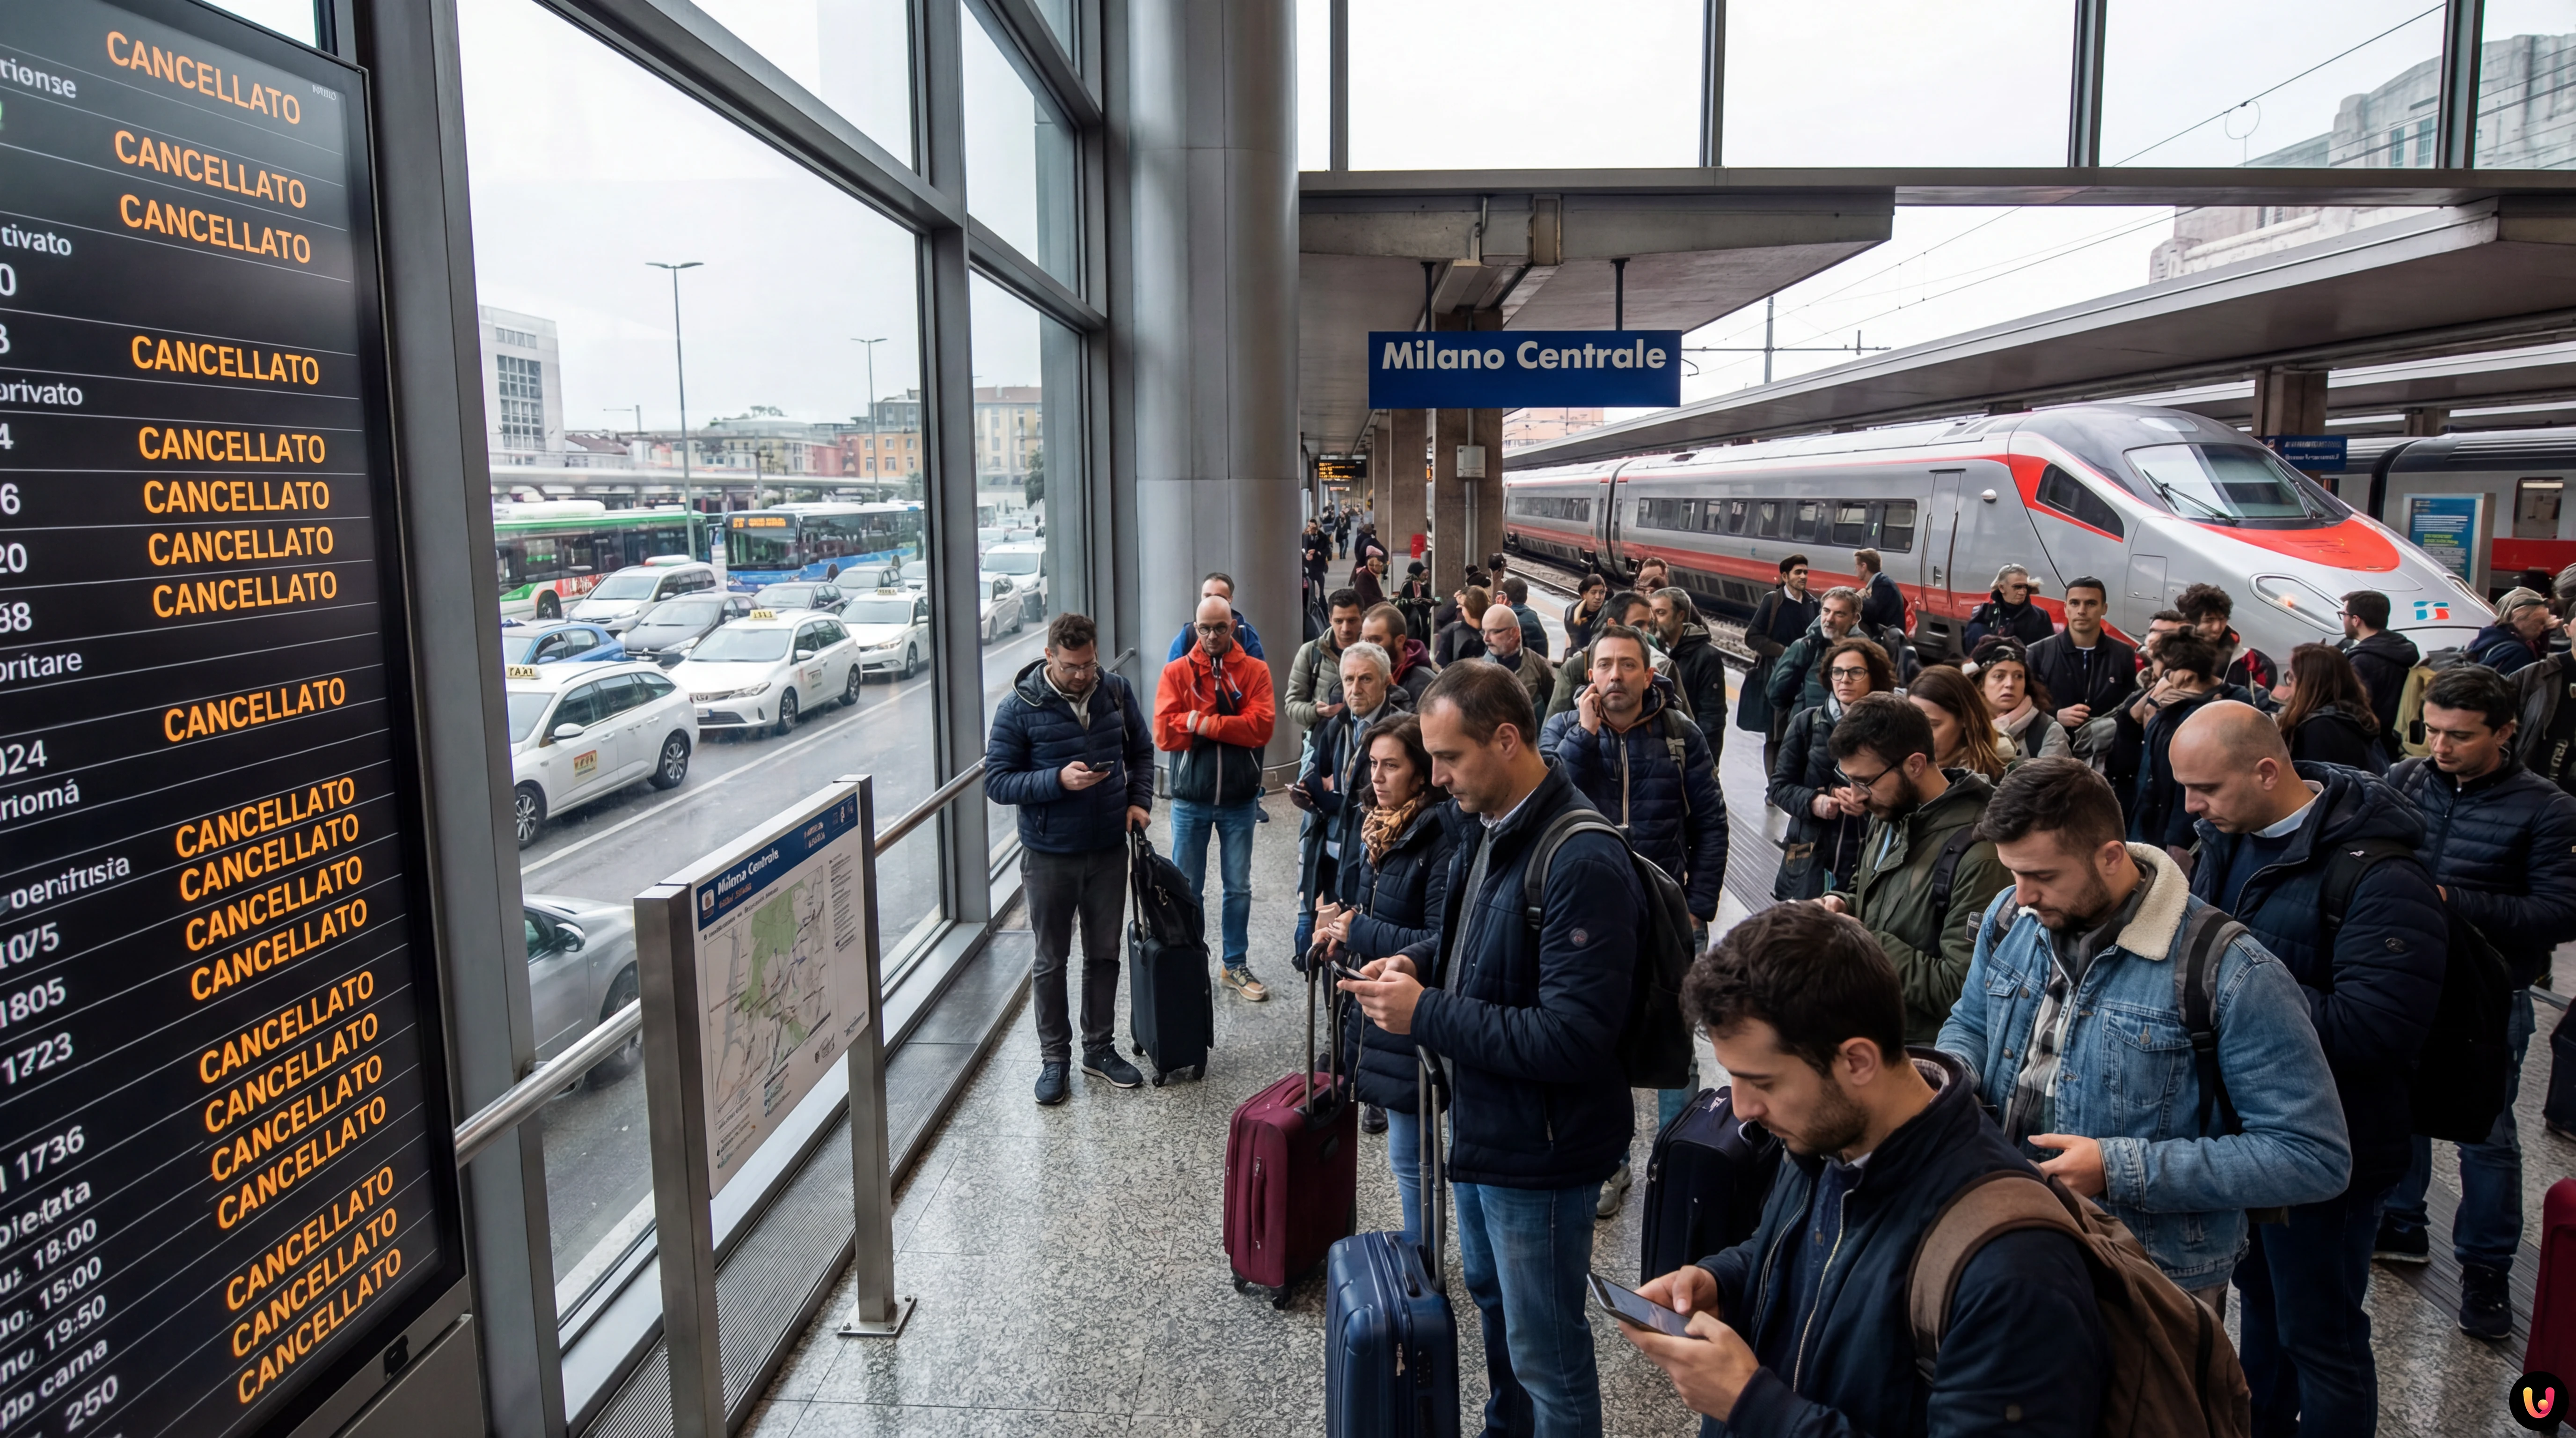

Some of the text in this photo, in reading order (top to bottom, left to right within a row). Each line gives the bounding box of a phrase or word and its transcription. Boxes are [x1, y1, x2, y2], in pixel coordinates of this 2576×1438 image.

[107, 31, 301, 125] CANCELLATO
[115, 130, 307, 208] CANCELLATO
[120, 194, 311, 264] CANCELLATO
[132, 336, 319, 385] CANCELLATO
[1382, 338, 1667, 370] Milano Centrale
[139, 426, 325, 463] CANCELLATO
[0, 483, 21, 514] 6
[144, 480, 329, 514] CANCELLATO
[148, 526, 333, 566] CANCELLATO
[153, 571, 337, 618] CANCELLATO
[164, 677, 345, 742] CANCELLATO
[176, 777, 354, 858] CANCELLATO
[180, 814, 359, 901] CANCELLATO
[186, 856, 362, 951] CANCELLATO
[191, 899, 367, 1000] CANCELLATO
[200, 971, 373, 1083] CANCELLATO
[205, 1013, 378, 1132] CANCELLATO
[16, 1125, 84, 1181] 1736
[212, 1055, 382, 1181] CANCELLATO
[218, 1096, 386, 1229] CANCELLATO
[227, 1167, 393, 1310] CANCELLATO
[233, 1208, 396, 1357] CANCELLATO
[239, 1248, 401, 1403] CANCELLATO
[66, 1375, 118, 1431] 250
